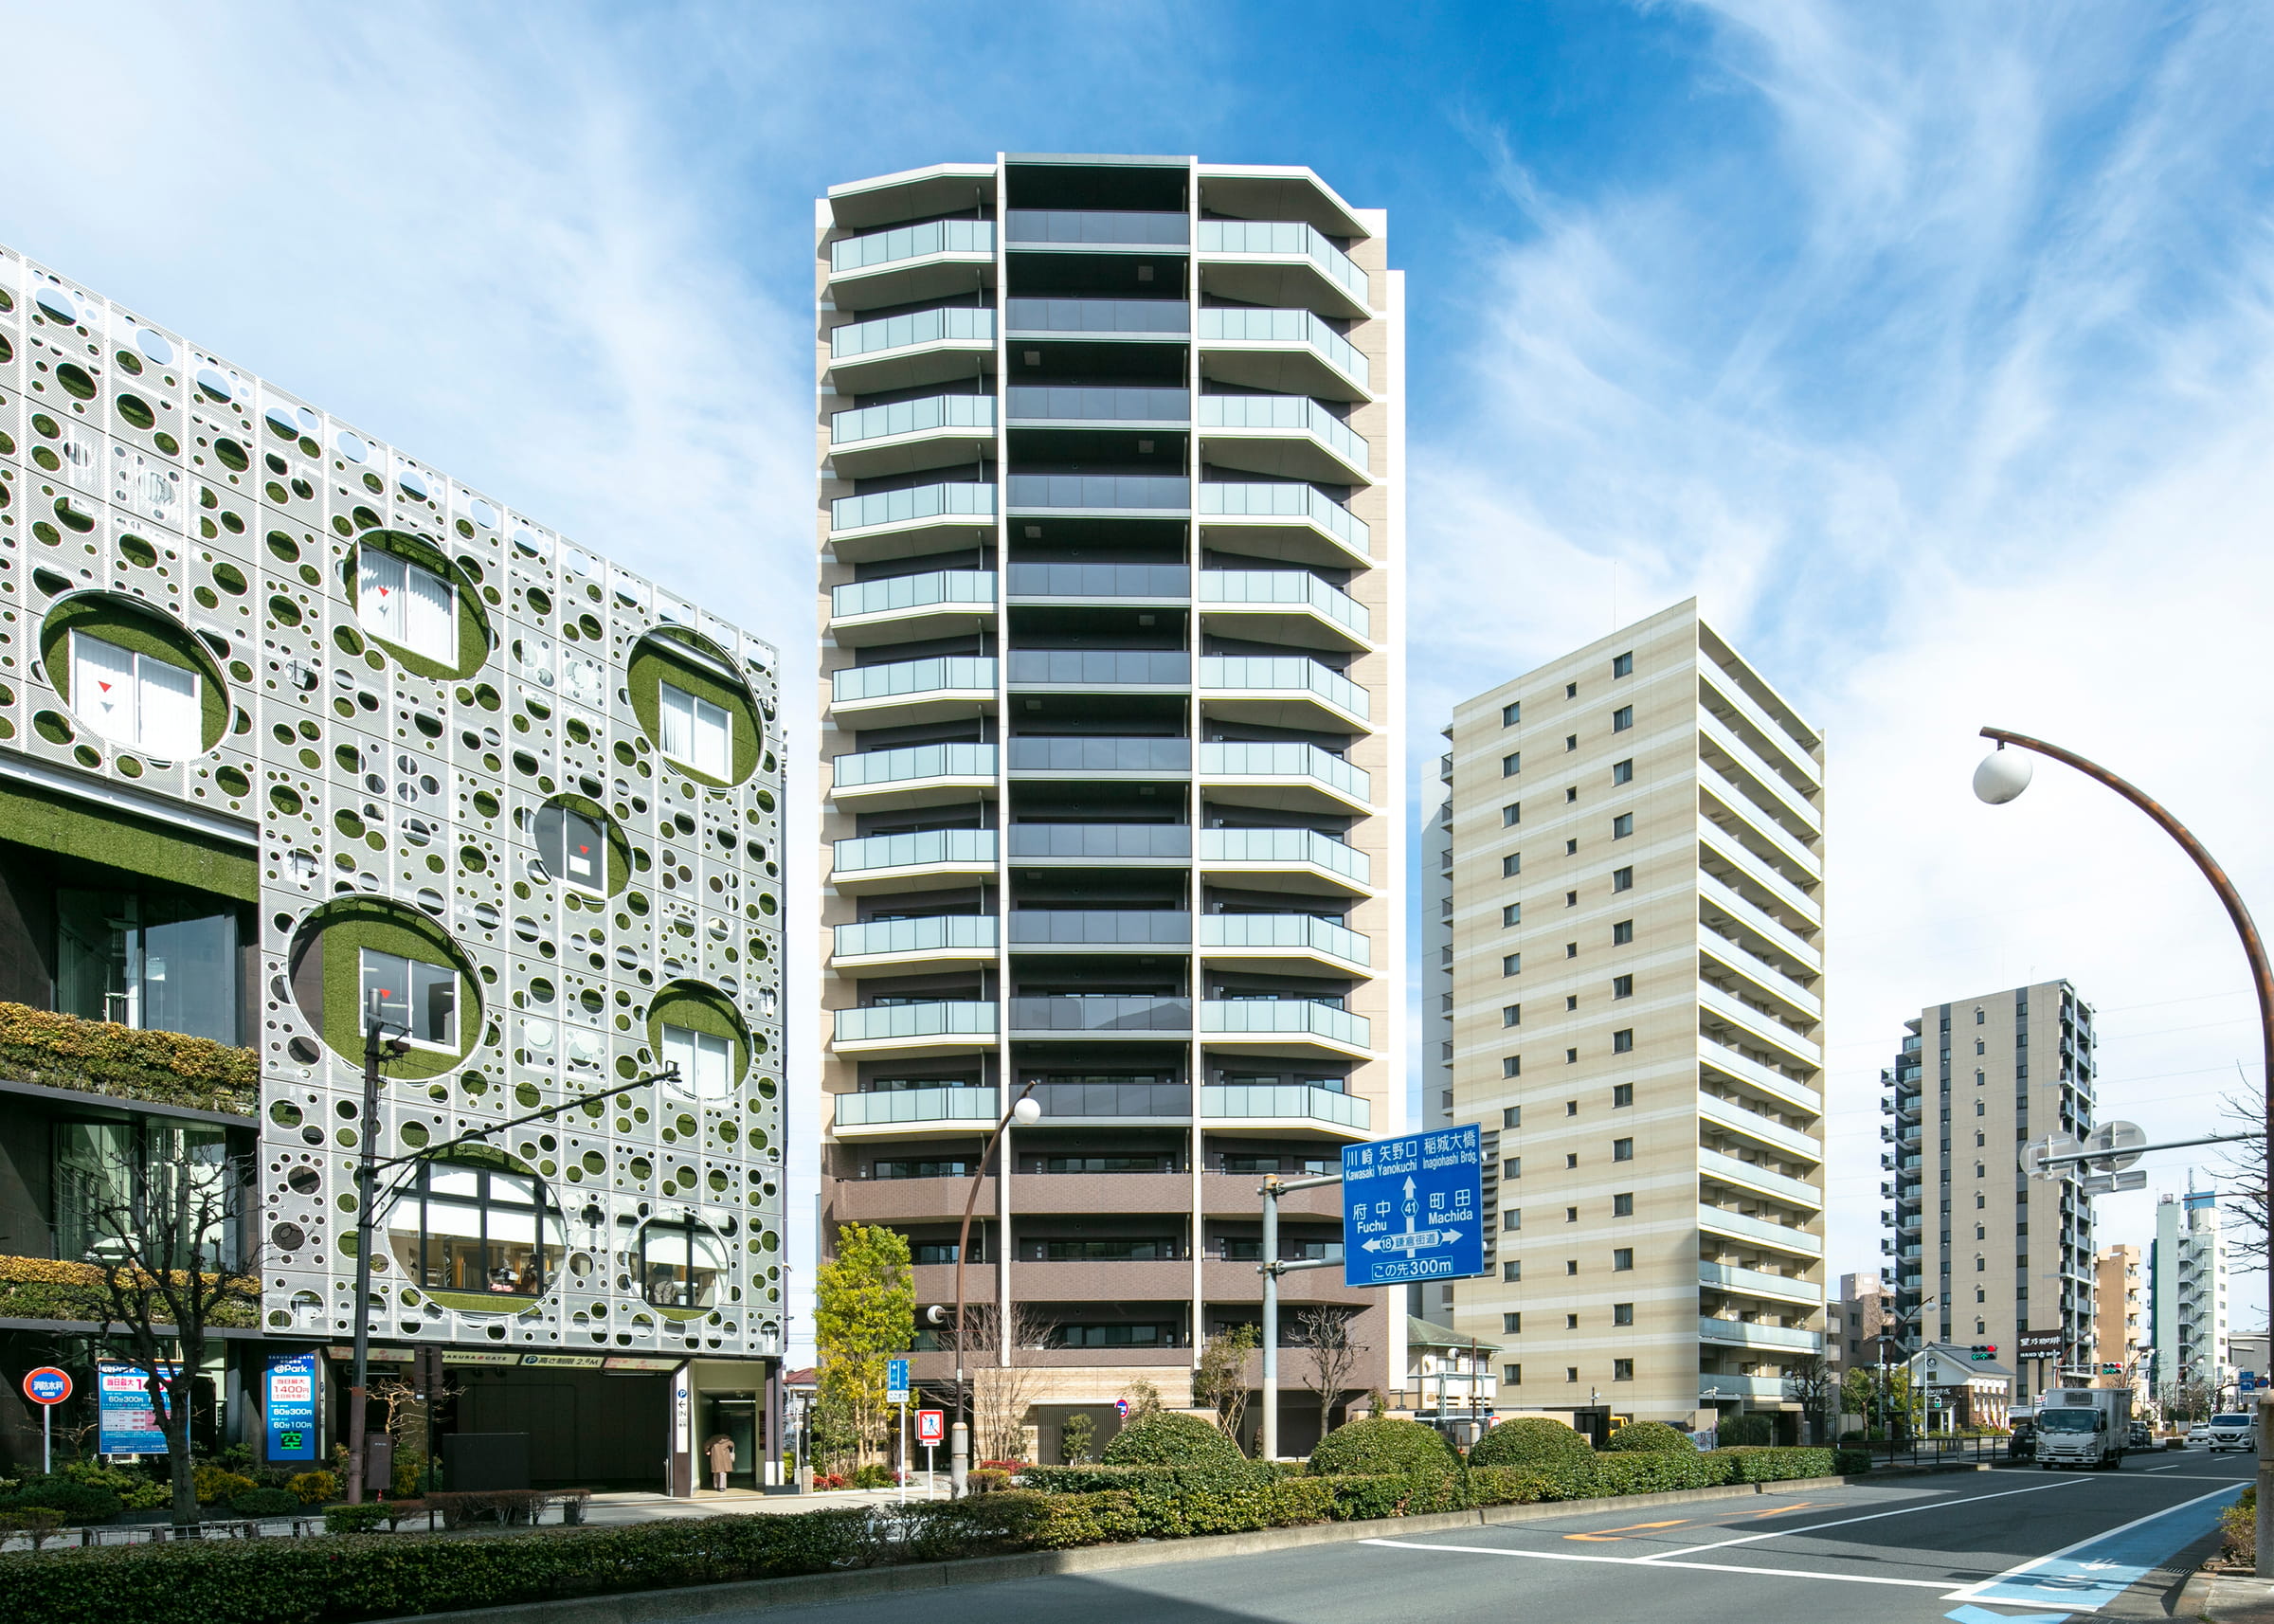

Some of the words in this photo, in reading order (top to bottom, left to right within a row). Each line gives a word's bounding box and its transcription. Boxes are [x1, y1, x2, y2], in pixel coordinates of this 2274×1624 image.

[1380, 1140, 1417, 1163] 矢野口
[1424, 1129, 1476, 1155] 稲城大橋
[1345, 1165, 1375, 1182] Kawasaki
[1377, 1158, 1417, 1177] Yanokuchi
[1404, 1201, 1416, 1214] 41
[1428, 1207, 1473, 1225] Machida
[1357, 1219, 1387, 1235] Fuchu
[1382, 1237, 1392, 1250] 18
[274, 1364, 308, 1373] @Park
[280, 1431, 302, 1450] 空
